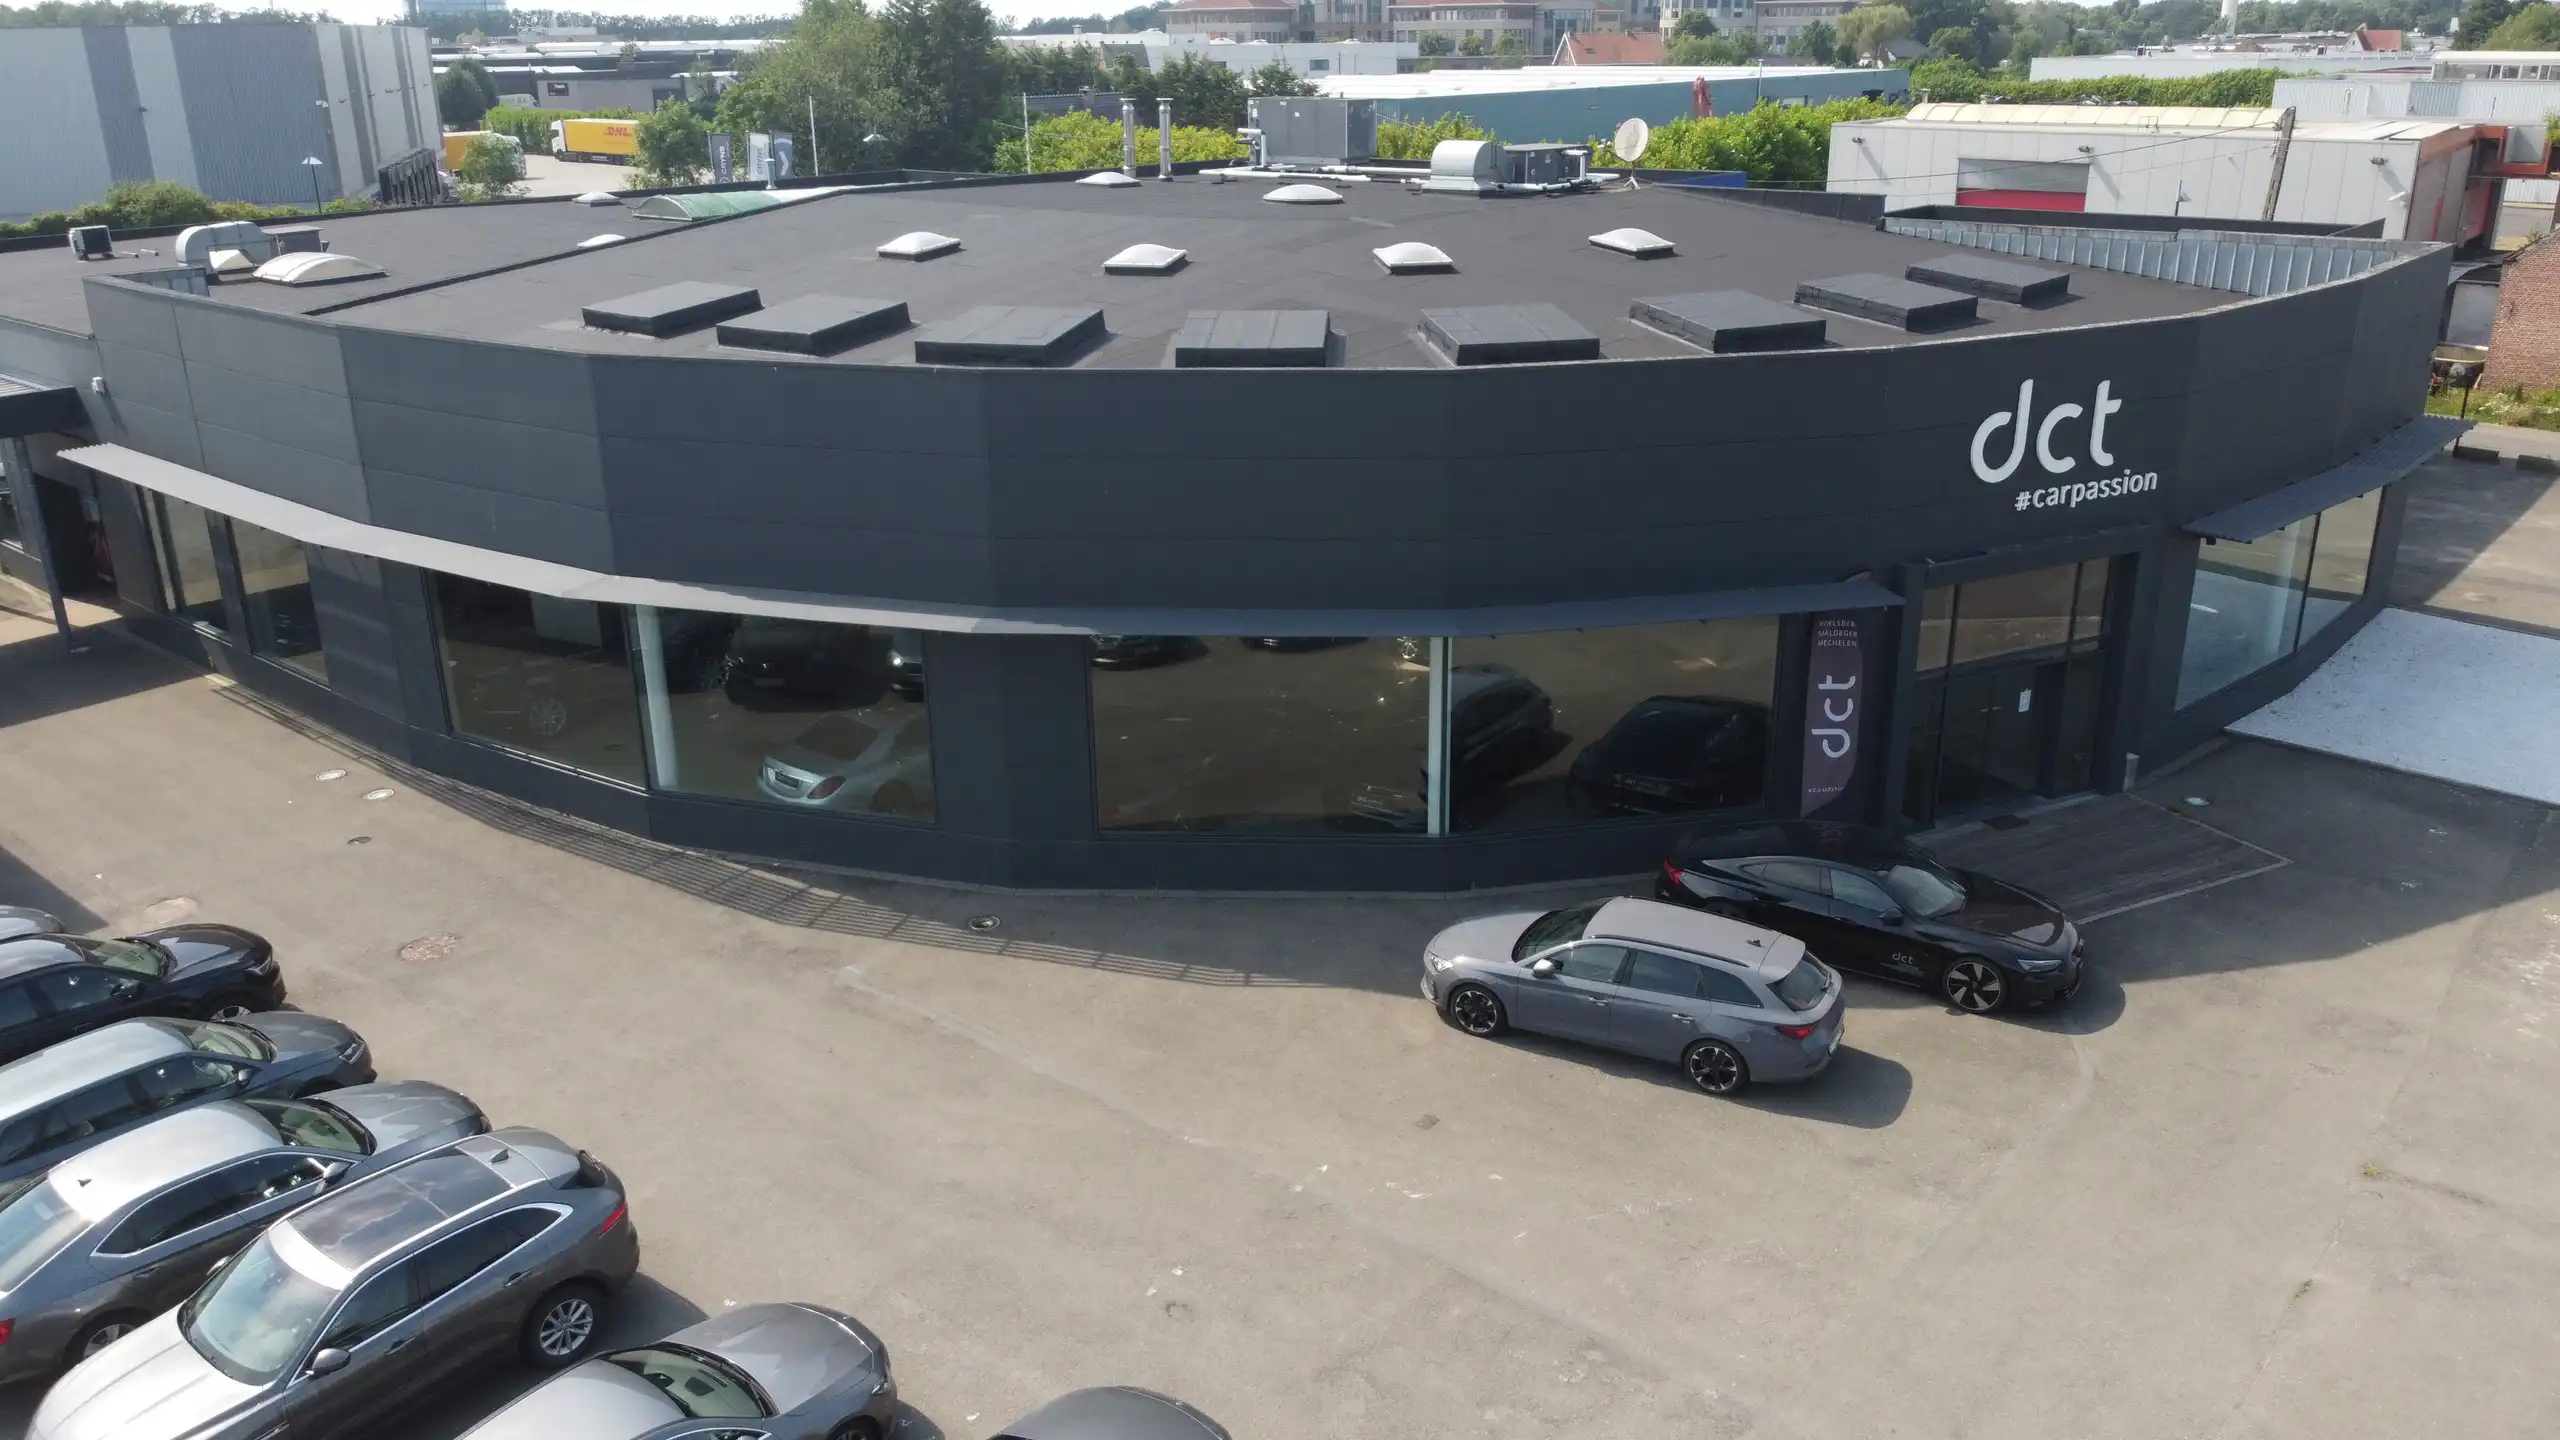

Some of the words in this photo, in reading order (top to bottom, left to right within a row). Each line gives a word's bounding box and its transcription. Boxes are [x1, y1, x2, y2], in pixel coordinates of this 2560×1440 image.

[605, 126, 630, 137] DHL
[719, 145, 728, 174] CRYNS
[1970, 379, 2122, 483] dct
[2014, 469, 2158, 511] #carpassion
[1811, 675, 1856, 758] dct
[1892, 952, 1914, 965] dct
